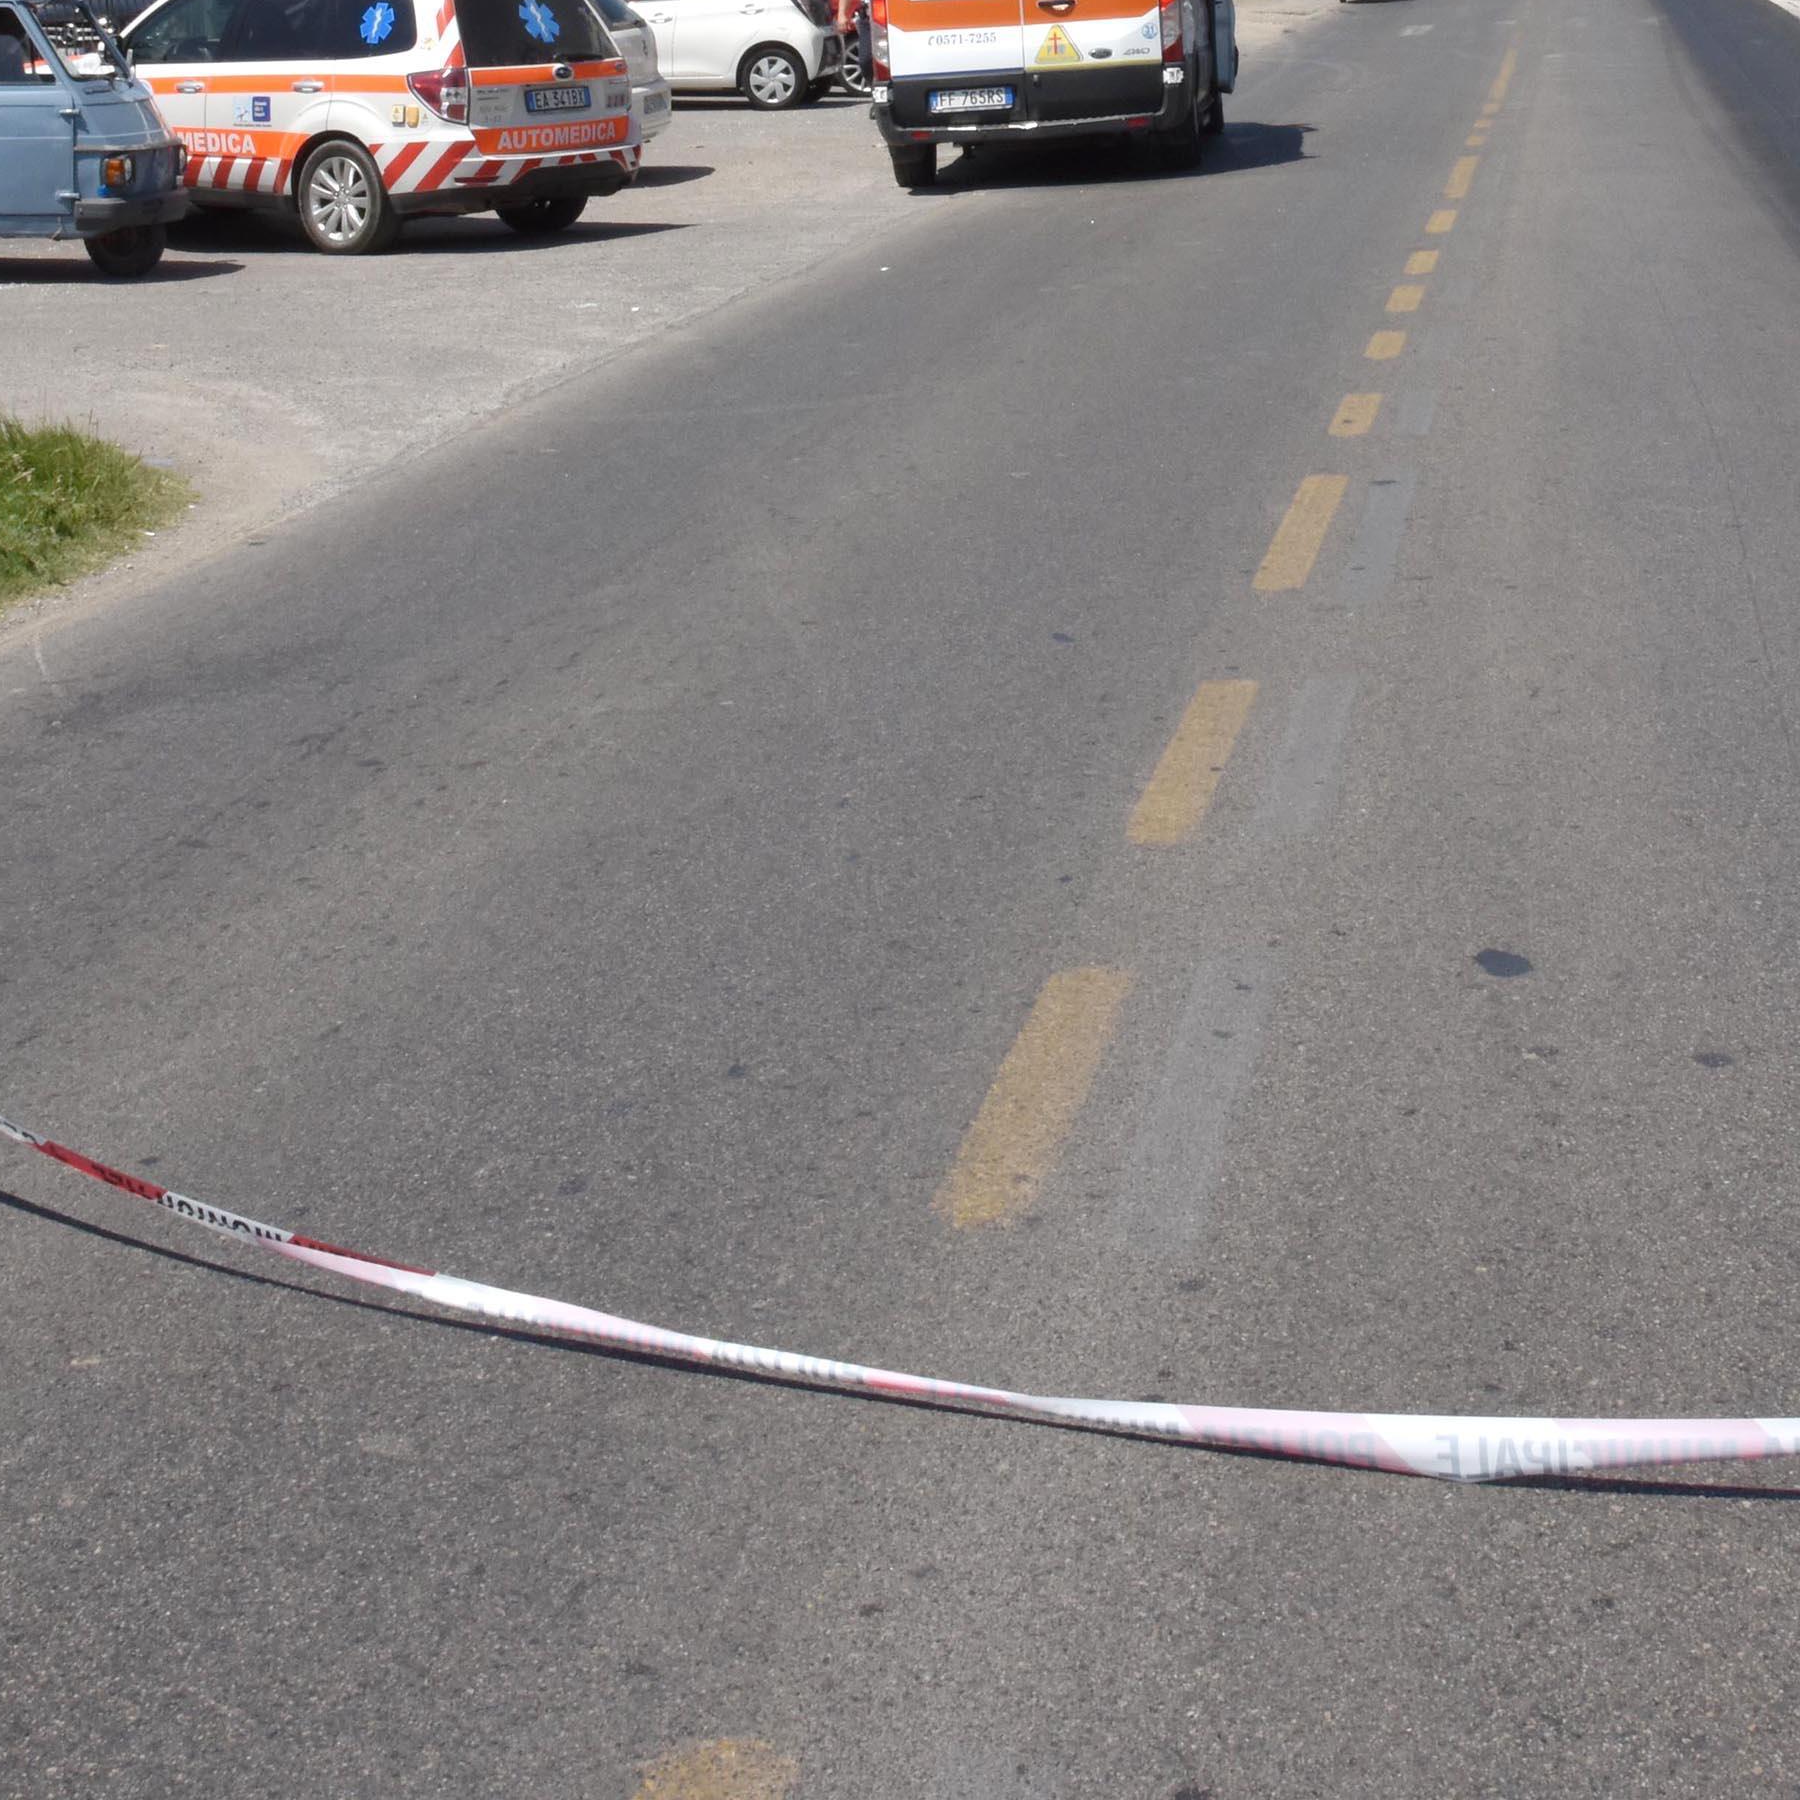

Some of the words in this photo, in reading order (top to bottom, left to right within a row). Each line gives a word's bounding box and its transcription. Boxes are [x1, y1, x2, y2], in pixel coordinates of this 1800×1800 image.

[535, 91, 550, 109] EA
[553, 86, 585, 108] 341BX
[940, 91, 955, 107] FF
[961, 88, 1005, 106] 765RS
[498, 121, 616, 150] AUTOMEDICA
